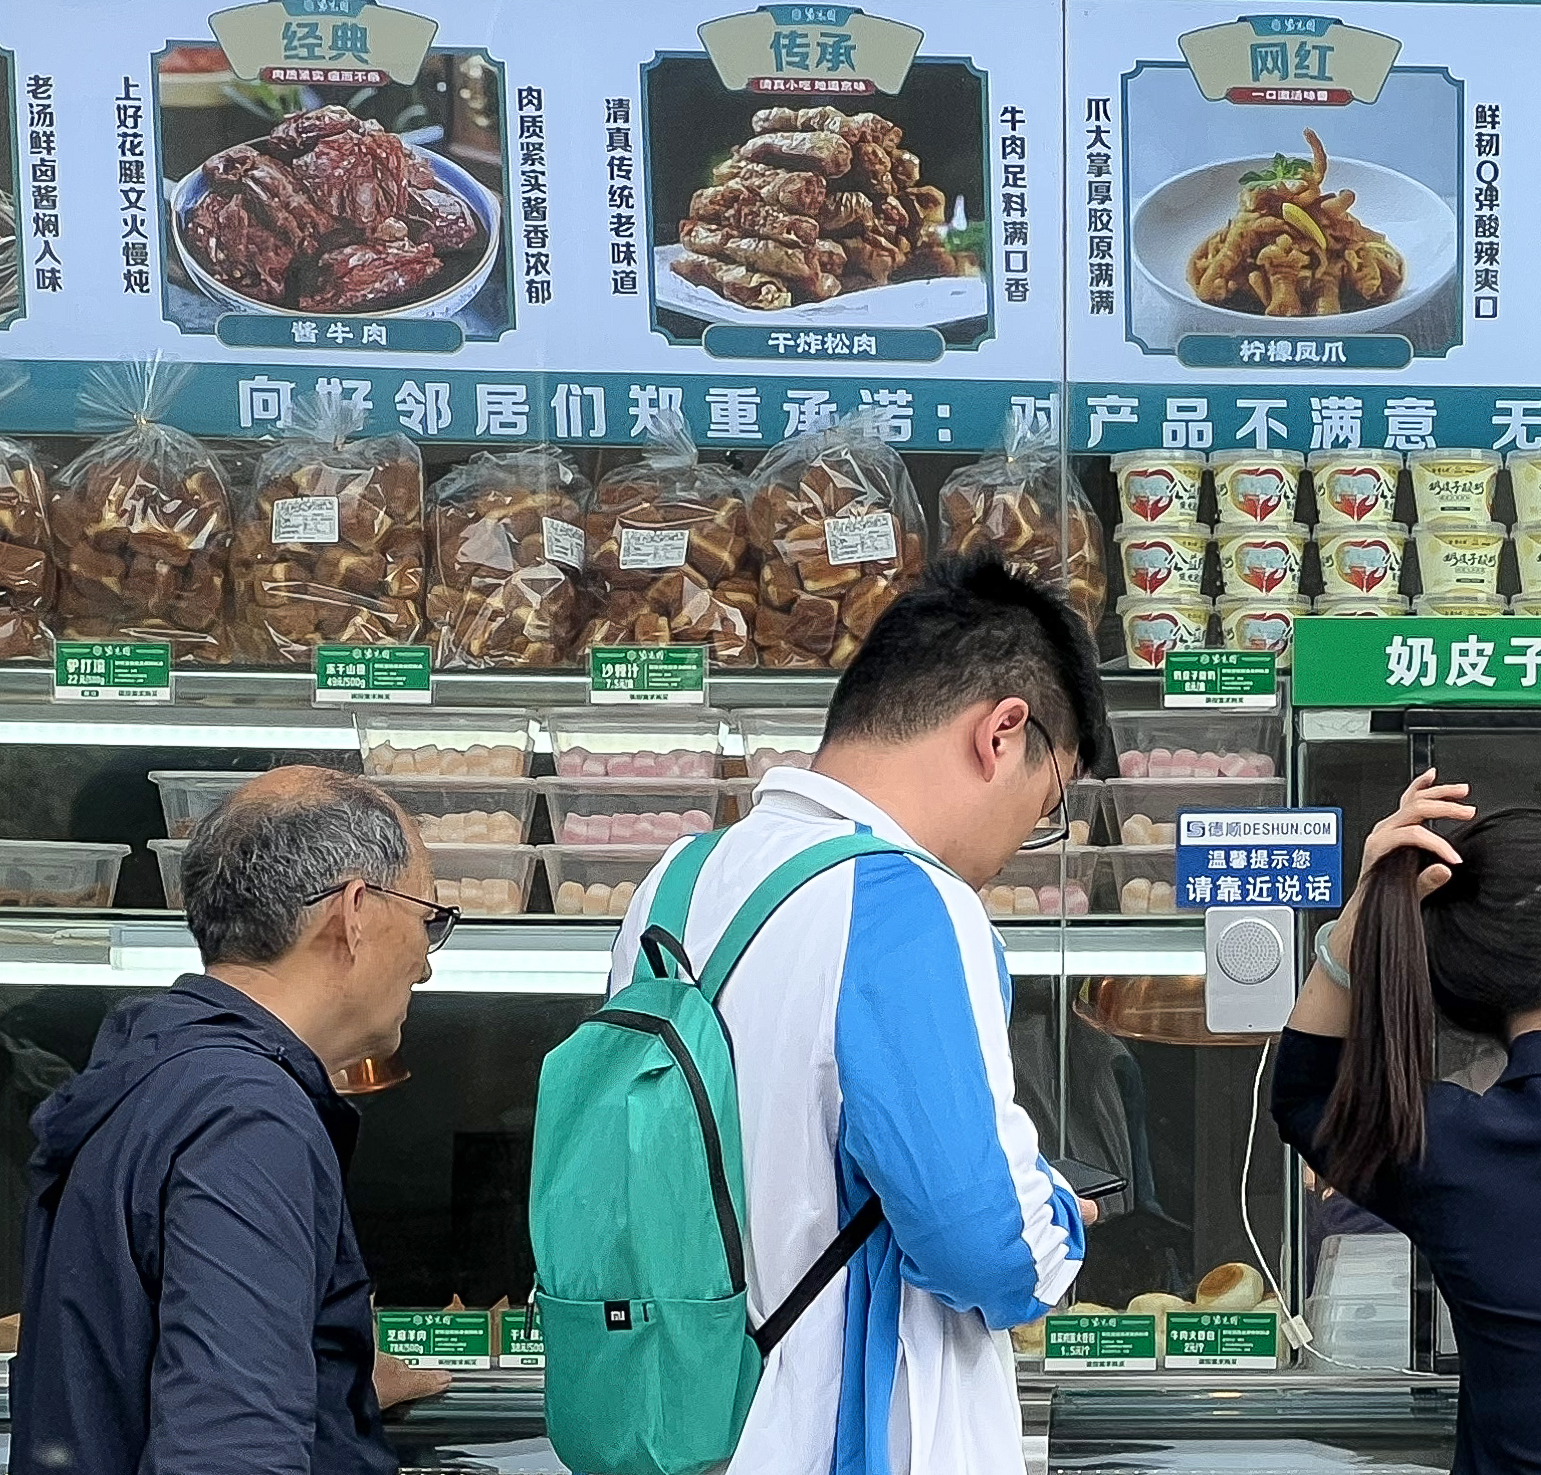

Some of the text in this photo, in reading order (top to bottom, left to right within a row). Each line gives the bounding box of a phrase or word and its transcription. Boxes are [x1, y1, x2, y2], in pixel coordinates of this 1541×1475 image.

[282, 21, 372, 65] 经典
[769, 30, 857, 73] 传承
[1250, 41, 1335, 83] 网红
[26, 74, 64, 293] 老汤鲜卤酱焖入味
[115, 75, 152, 296] 上好花腱文火慢炖
[516, 85, 553, 305] 肉质紧实酱香浓郁
[604, 97, 638, 296] 清真传统老味道
[999, 105, 1031, 304] 牛肉足料满口香
[1085, 97, 1115, 316] 爪大掌厚胶原满满
[1474, 103, 1501, 320] 鲜韧Q弹酸辣爽口
[290, 320, 389, 346] 酱牛肉
[767, 331, 877, 356] 干炸松肉
[1238, 339, 1348, 364] 柠檬凤爪
[1208, 821, 1331, 837] 德顺DESHUN.COM
[1207, 848, 1312, 870] 温馨提示您
[1186, 874, 1332, 903] 请靠近说话
